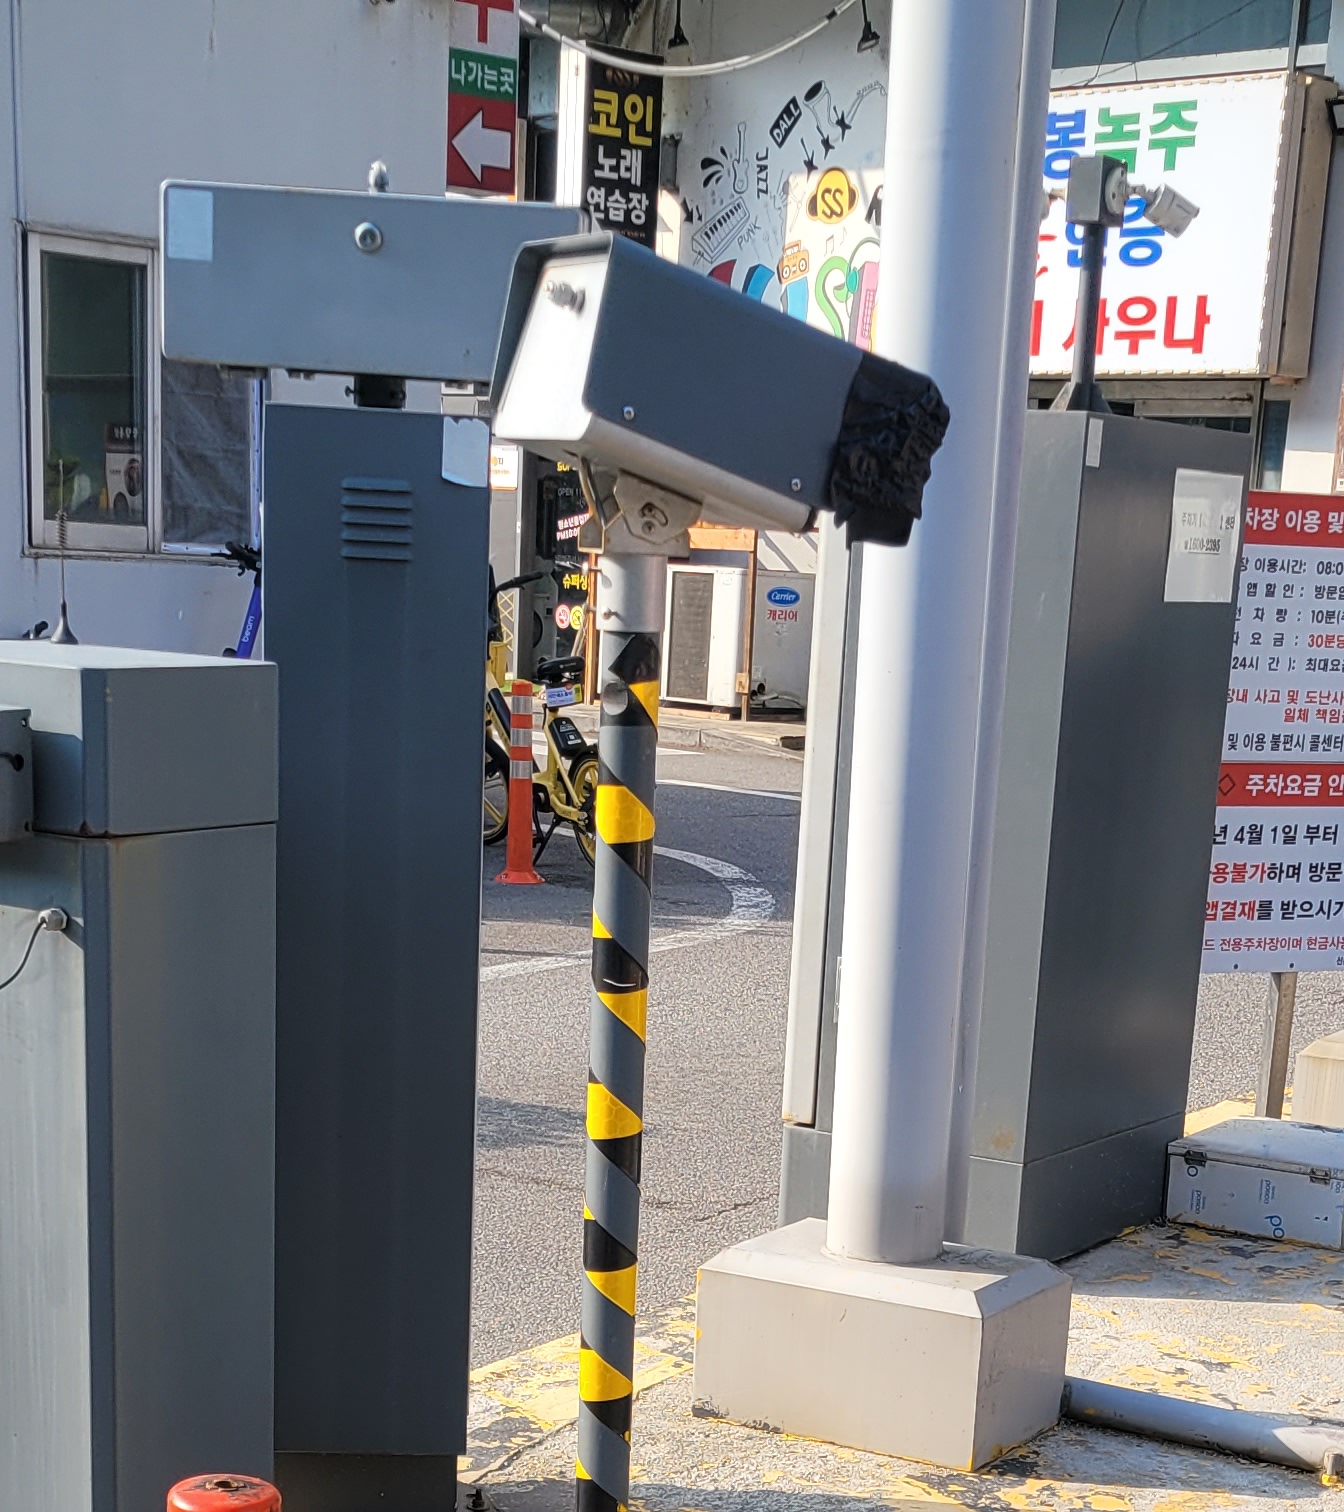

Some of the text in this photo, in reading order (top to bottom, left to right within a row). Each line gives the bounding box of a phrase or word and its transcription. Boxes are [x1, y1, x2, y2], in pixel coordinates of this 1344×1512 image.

[451, 60, 514, 95] 나가는곳
[588, 89, 653, 146] 코인
[594, 145, 642, 187] 노래
[755, 147, 769, 199] JAZZ
[586, 186, 649, 225] 연습장
[737, 222, 762, 250] PUNK
[1285, 509, 1321, 533] 이용
[1327, 511, 1344, 534] 및
[771, 591, 797, 602] Carrier
[767, 609, 798, 622] 캐리어
[241, 616, 255, 643] beam
[1255, 689, 1281, 705] 사고
[1287, 689, 1299, 705] 및
[1284, 708, 1309, 723] 일체
[1227, 733, 1238, 750] 및
[1242, 733, 1267, 752] 이용
[1270, 734, 1305, 752] 불편시
[1309, 734, 1344, 752] 콜센터
[1245, 774, 1322, 797] 주차요금
[1233, 823, 1264, 845] 4월
[1270, 823, 1298, 845] 1일
[1303, 824, 1339, 845] 부터
[1209, 862, 1302, 884] 용불가하며
[1219, 937, 1302, 952] 전용주차장이며
